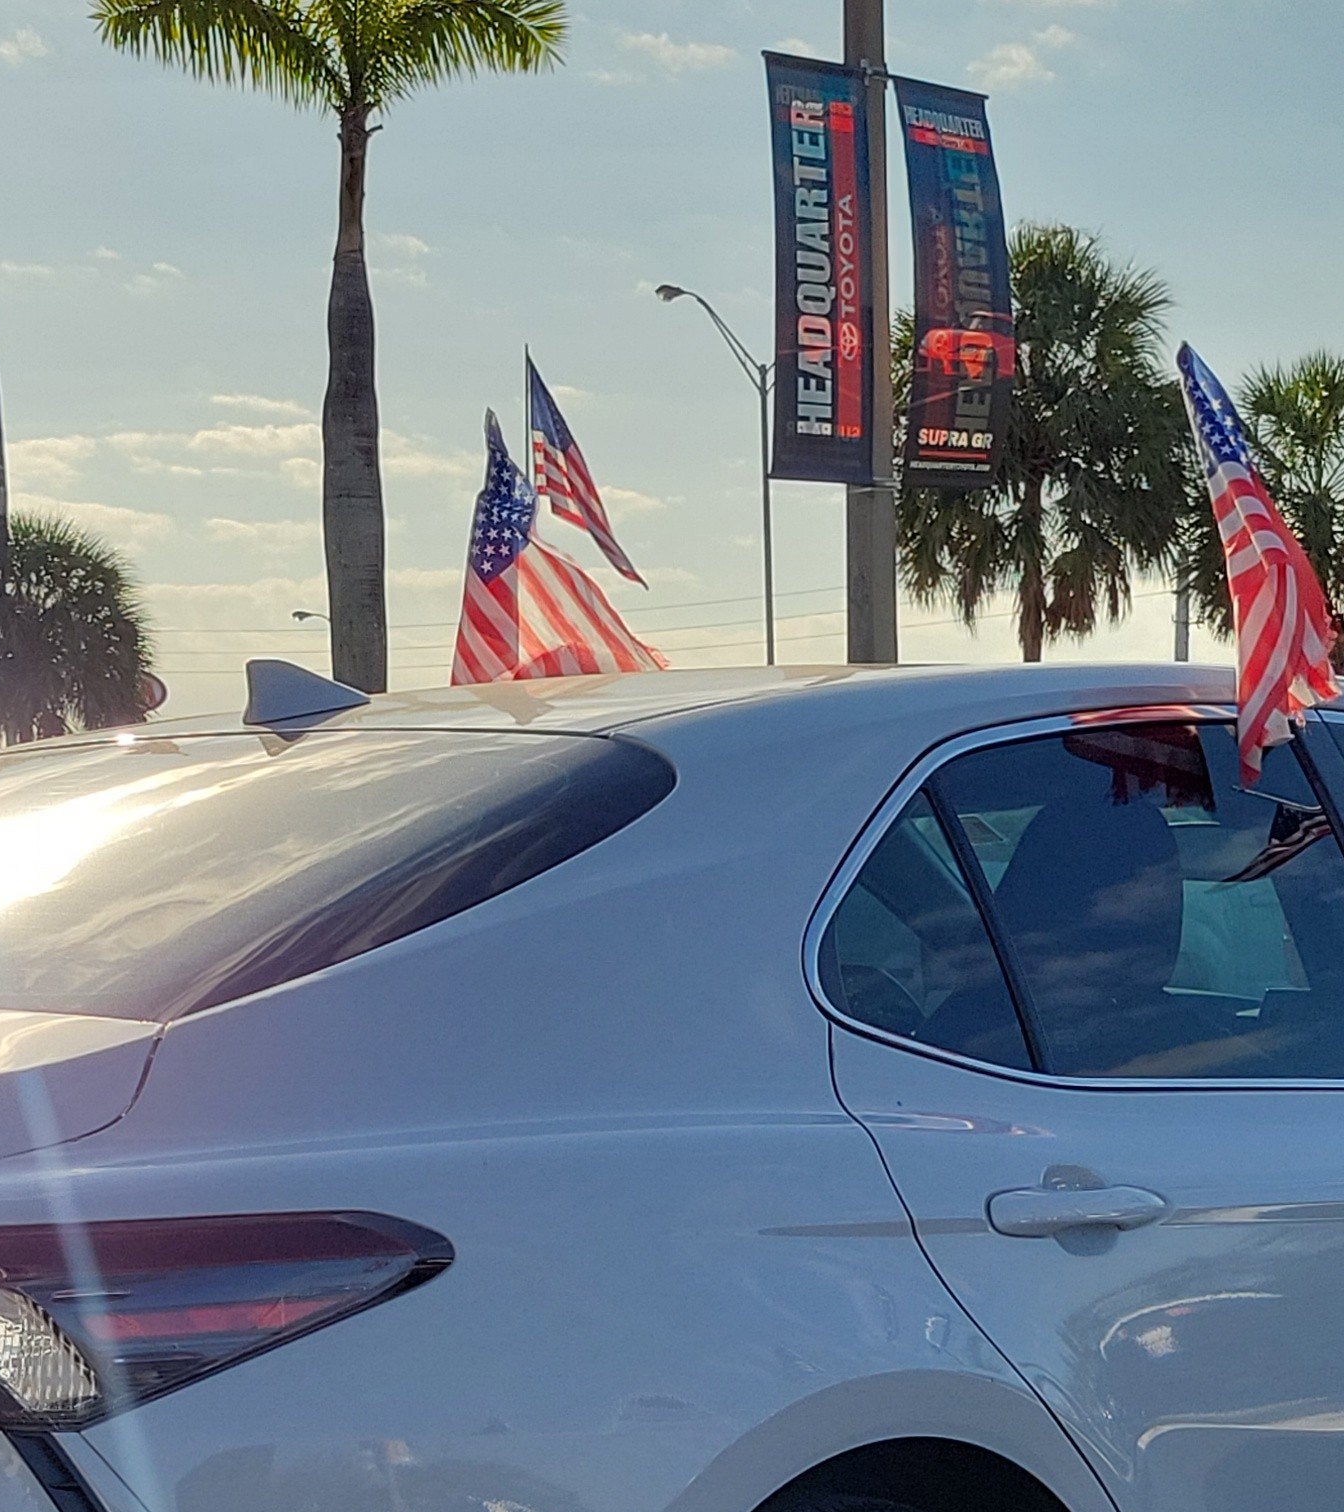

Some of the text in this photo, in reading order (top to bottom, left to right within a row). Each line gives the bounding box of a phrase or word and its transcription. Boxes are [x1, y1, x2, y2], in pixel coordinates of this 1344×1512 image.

[791, 99, 836, 436] HEADQUARTER
[839, 194, 857, 318] TOYOTA
[918, 428, 994, 449] SUPRA GR
